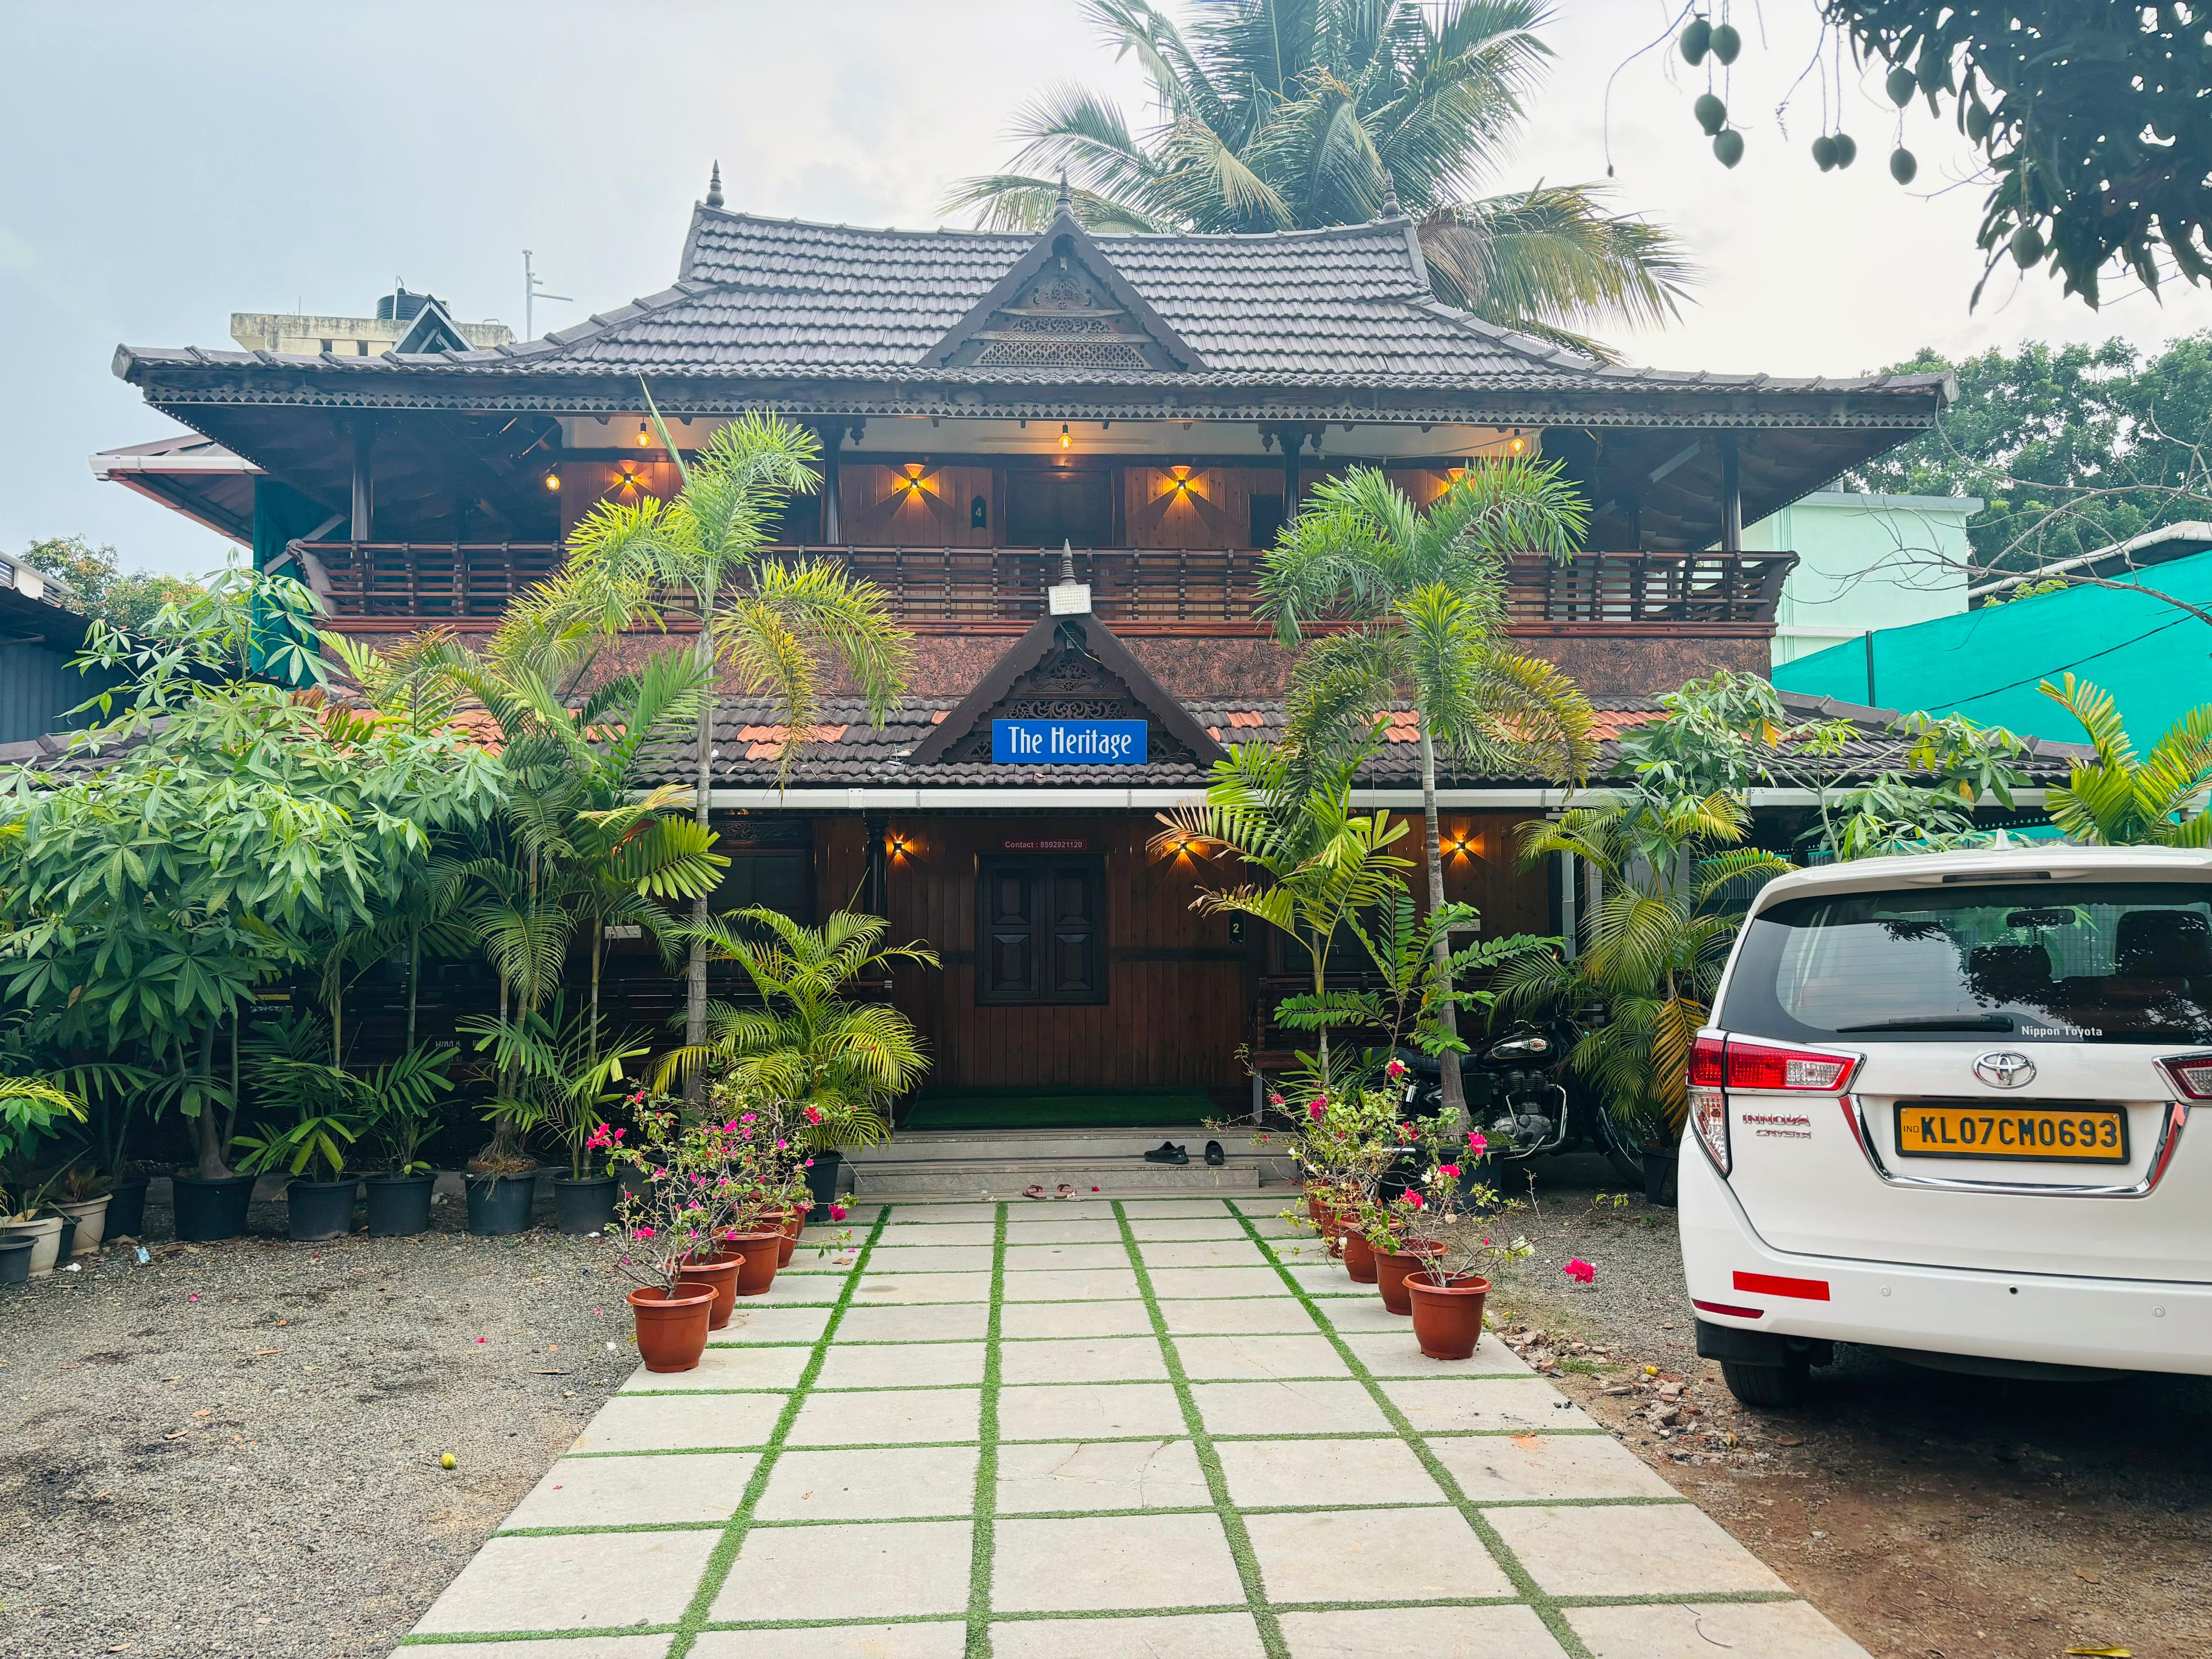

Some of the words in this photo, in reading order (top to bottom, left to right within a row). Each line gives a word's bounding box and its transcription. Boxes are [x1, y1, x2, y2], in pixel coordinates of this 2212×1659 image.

[975, 507, 982, 518] 4
[1008, 726, 1043, 754] The
[1051, 726, 1133, 759] Heritage
[1233, 923, 1239, 934] 2
[2021, 1025, 2060, 1038] Nippon
[2063, 1026, 2103, 1038] Toyota
[1742, 1112, 1811, 1127] INNOVA
[1903, 1125, 1920, 1133] IND
[1920, 1116, 2118, 1148] KL07CM0693
